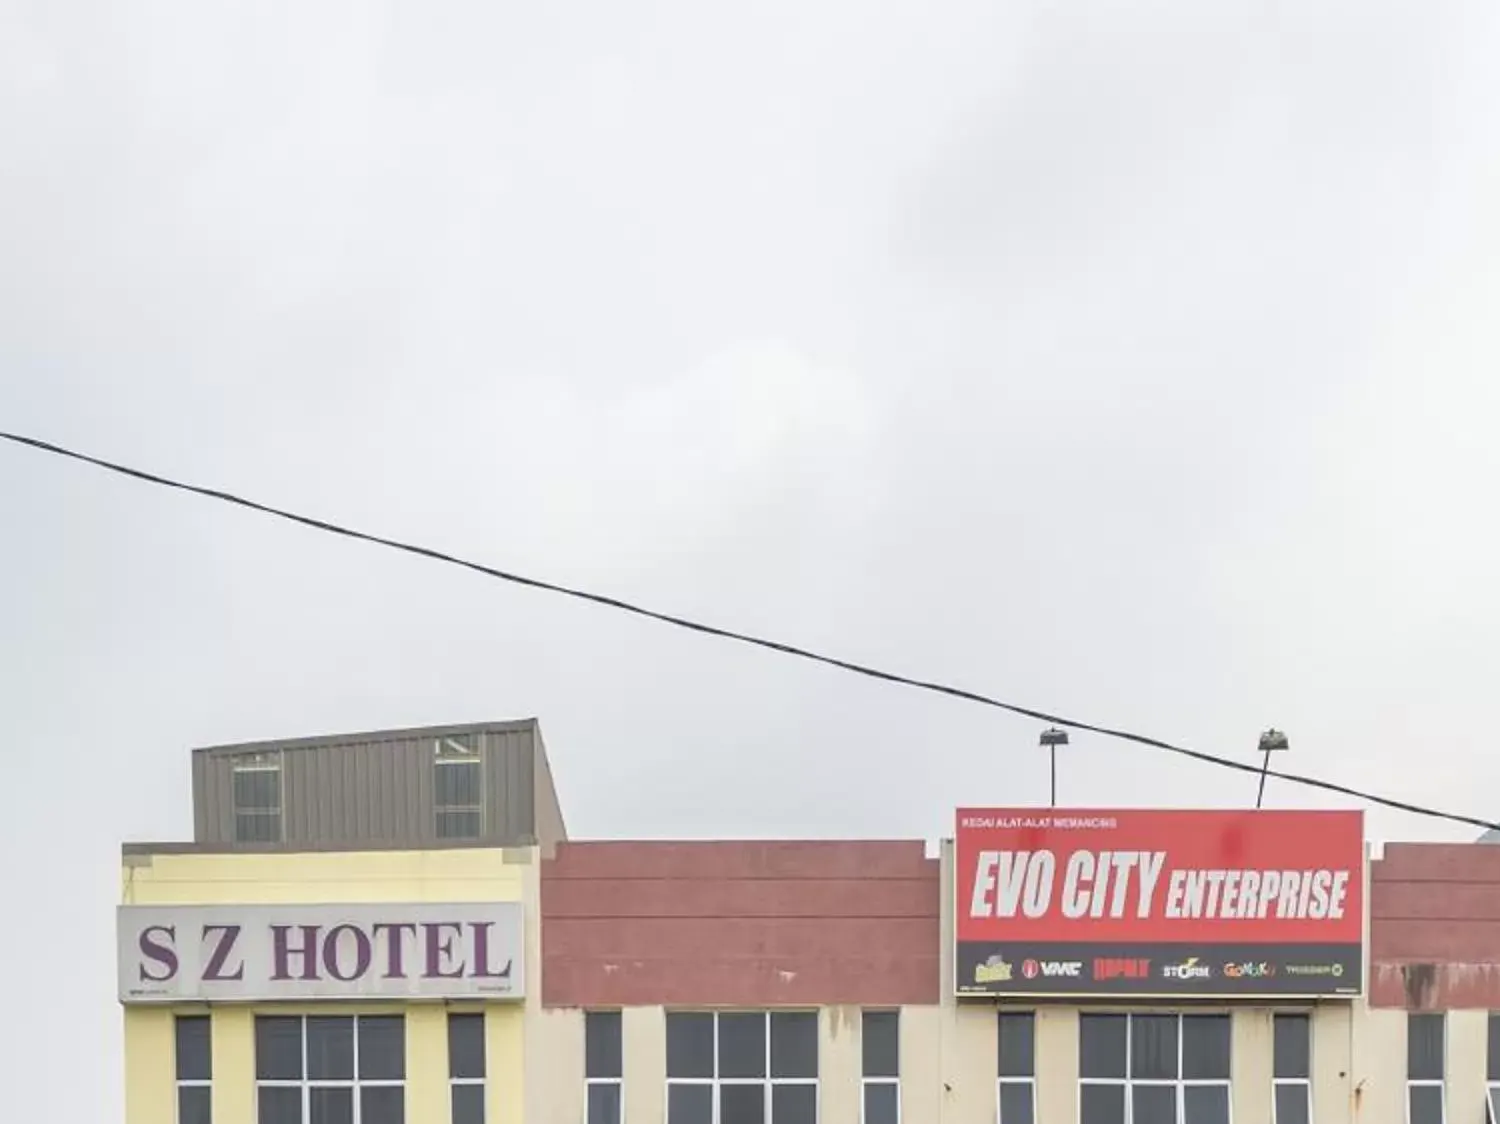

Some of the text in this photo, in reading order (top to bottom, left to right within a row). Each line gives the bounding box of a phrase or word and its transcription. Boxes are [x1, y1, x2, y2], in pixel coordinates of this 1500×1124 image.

[970, 849, 1349, 919] EVO CITY ENTERPRISE
[139, 921, 513, 982] S Z HOTEL
